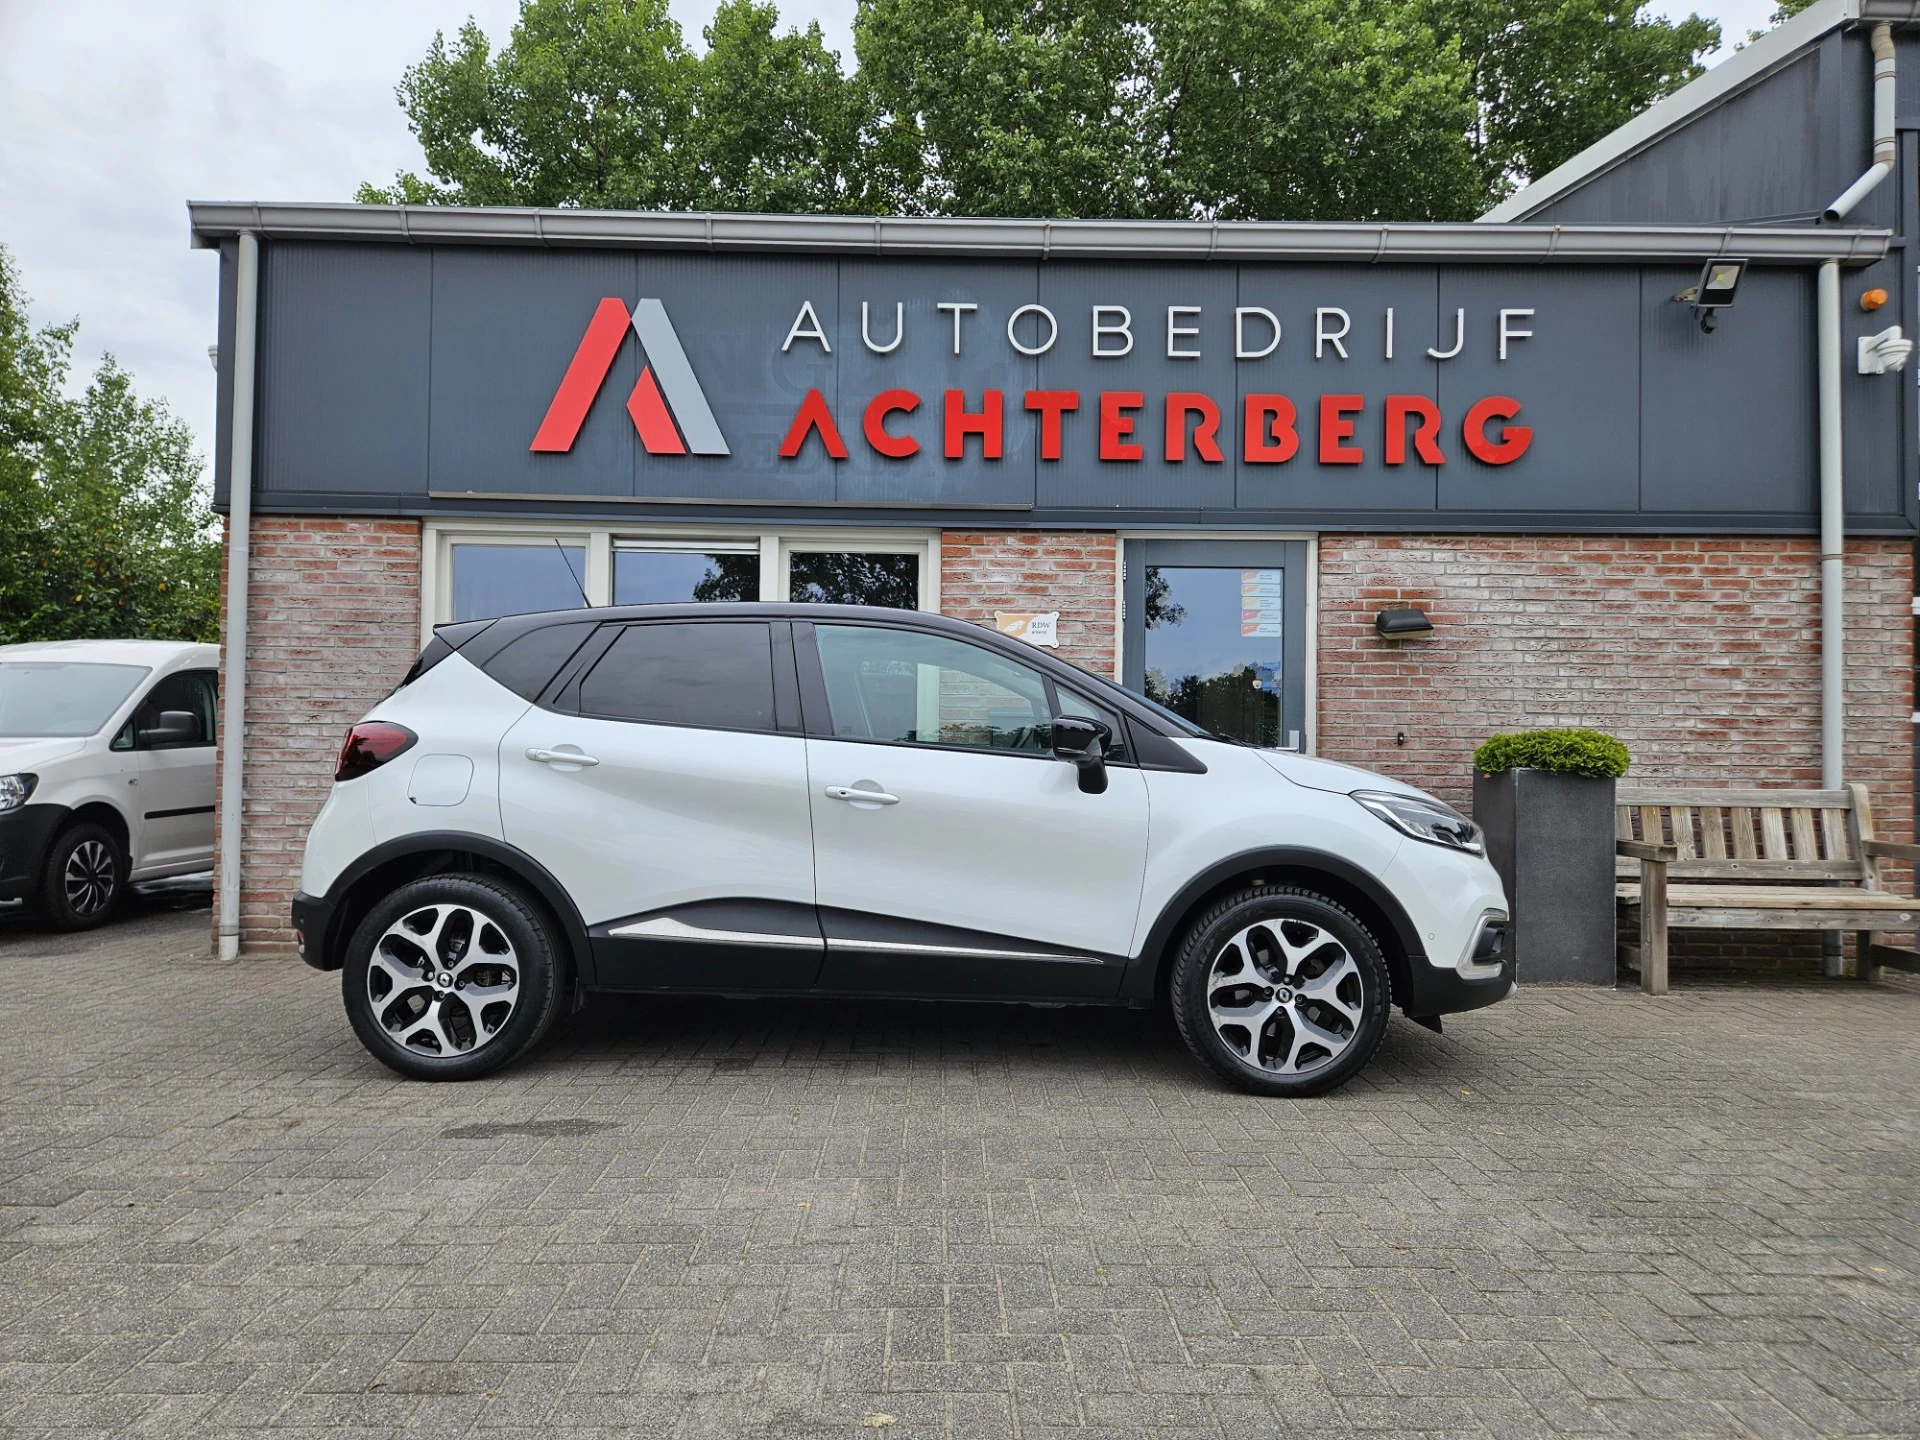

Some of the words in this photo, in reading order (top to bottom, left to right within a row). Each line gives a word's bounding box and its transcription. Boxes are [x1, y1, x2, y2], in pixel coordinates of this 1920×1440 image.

[781, 300, 1535, 360] AUTOBEDRIJF
[778, 388, 1533, 465] ACHTERBERG
[1031, 621, 1051, 629] RDW
